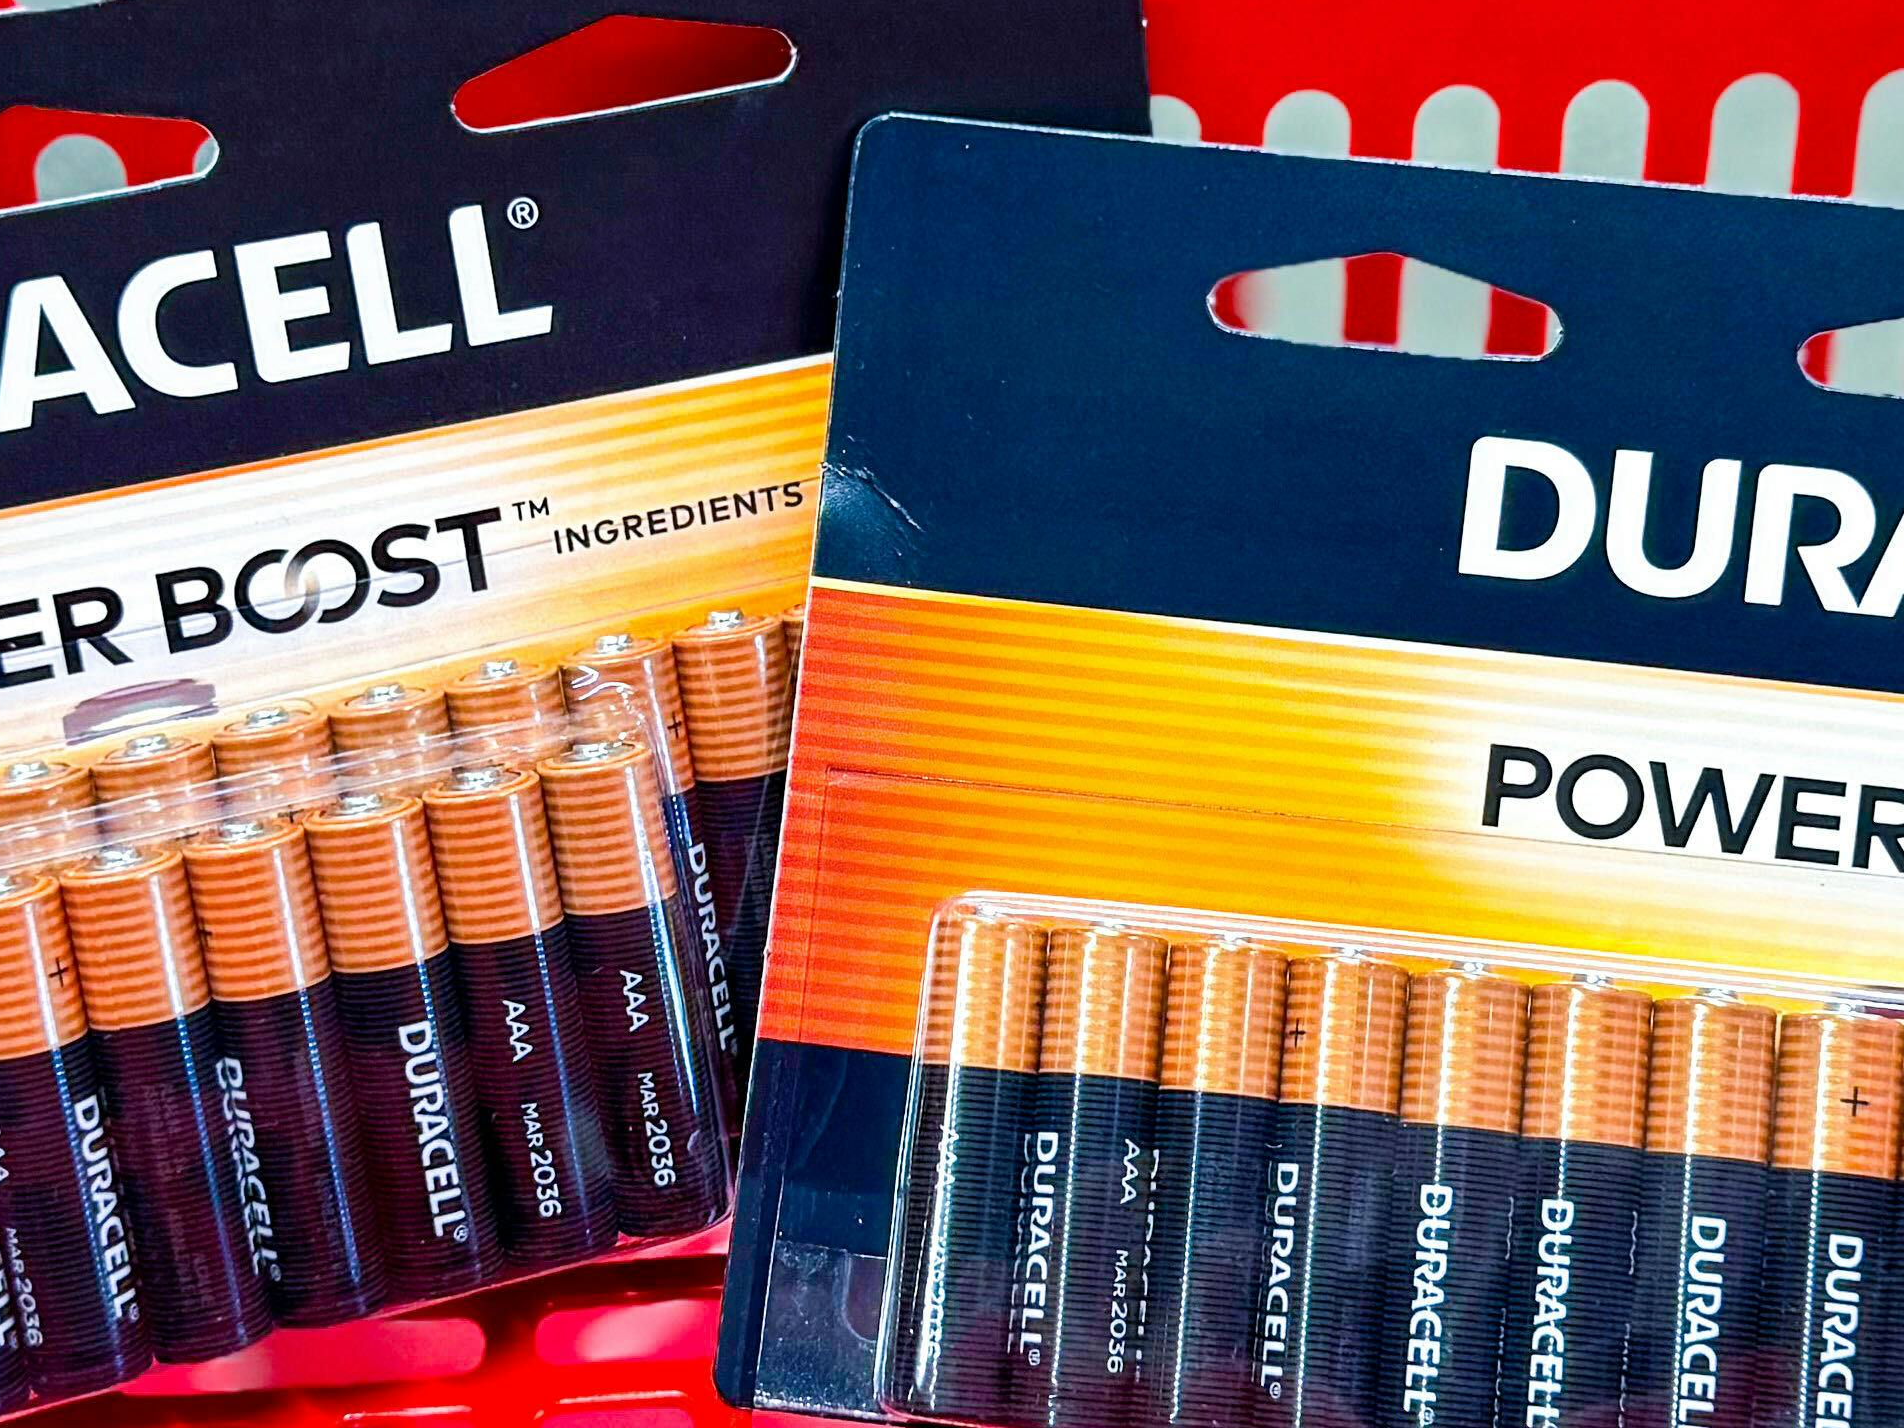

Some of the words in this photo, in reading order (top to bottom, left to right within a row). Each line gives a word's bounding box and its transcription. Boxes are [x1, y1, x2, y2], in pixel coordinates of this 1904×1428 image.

[553, 481, 804, 554] INGREDIENTS
[502, 999, 533, 1062] AAA
[530, 1149, 563, 1219] 2036
[619, 970, 650, 1032] AAA
[646, 1118, 677, 1187] 2036
[1120, 1138, 1139, 1205] AAA
[1107, 1302, 1127, 1374] 2036
